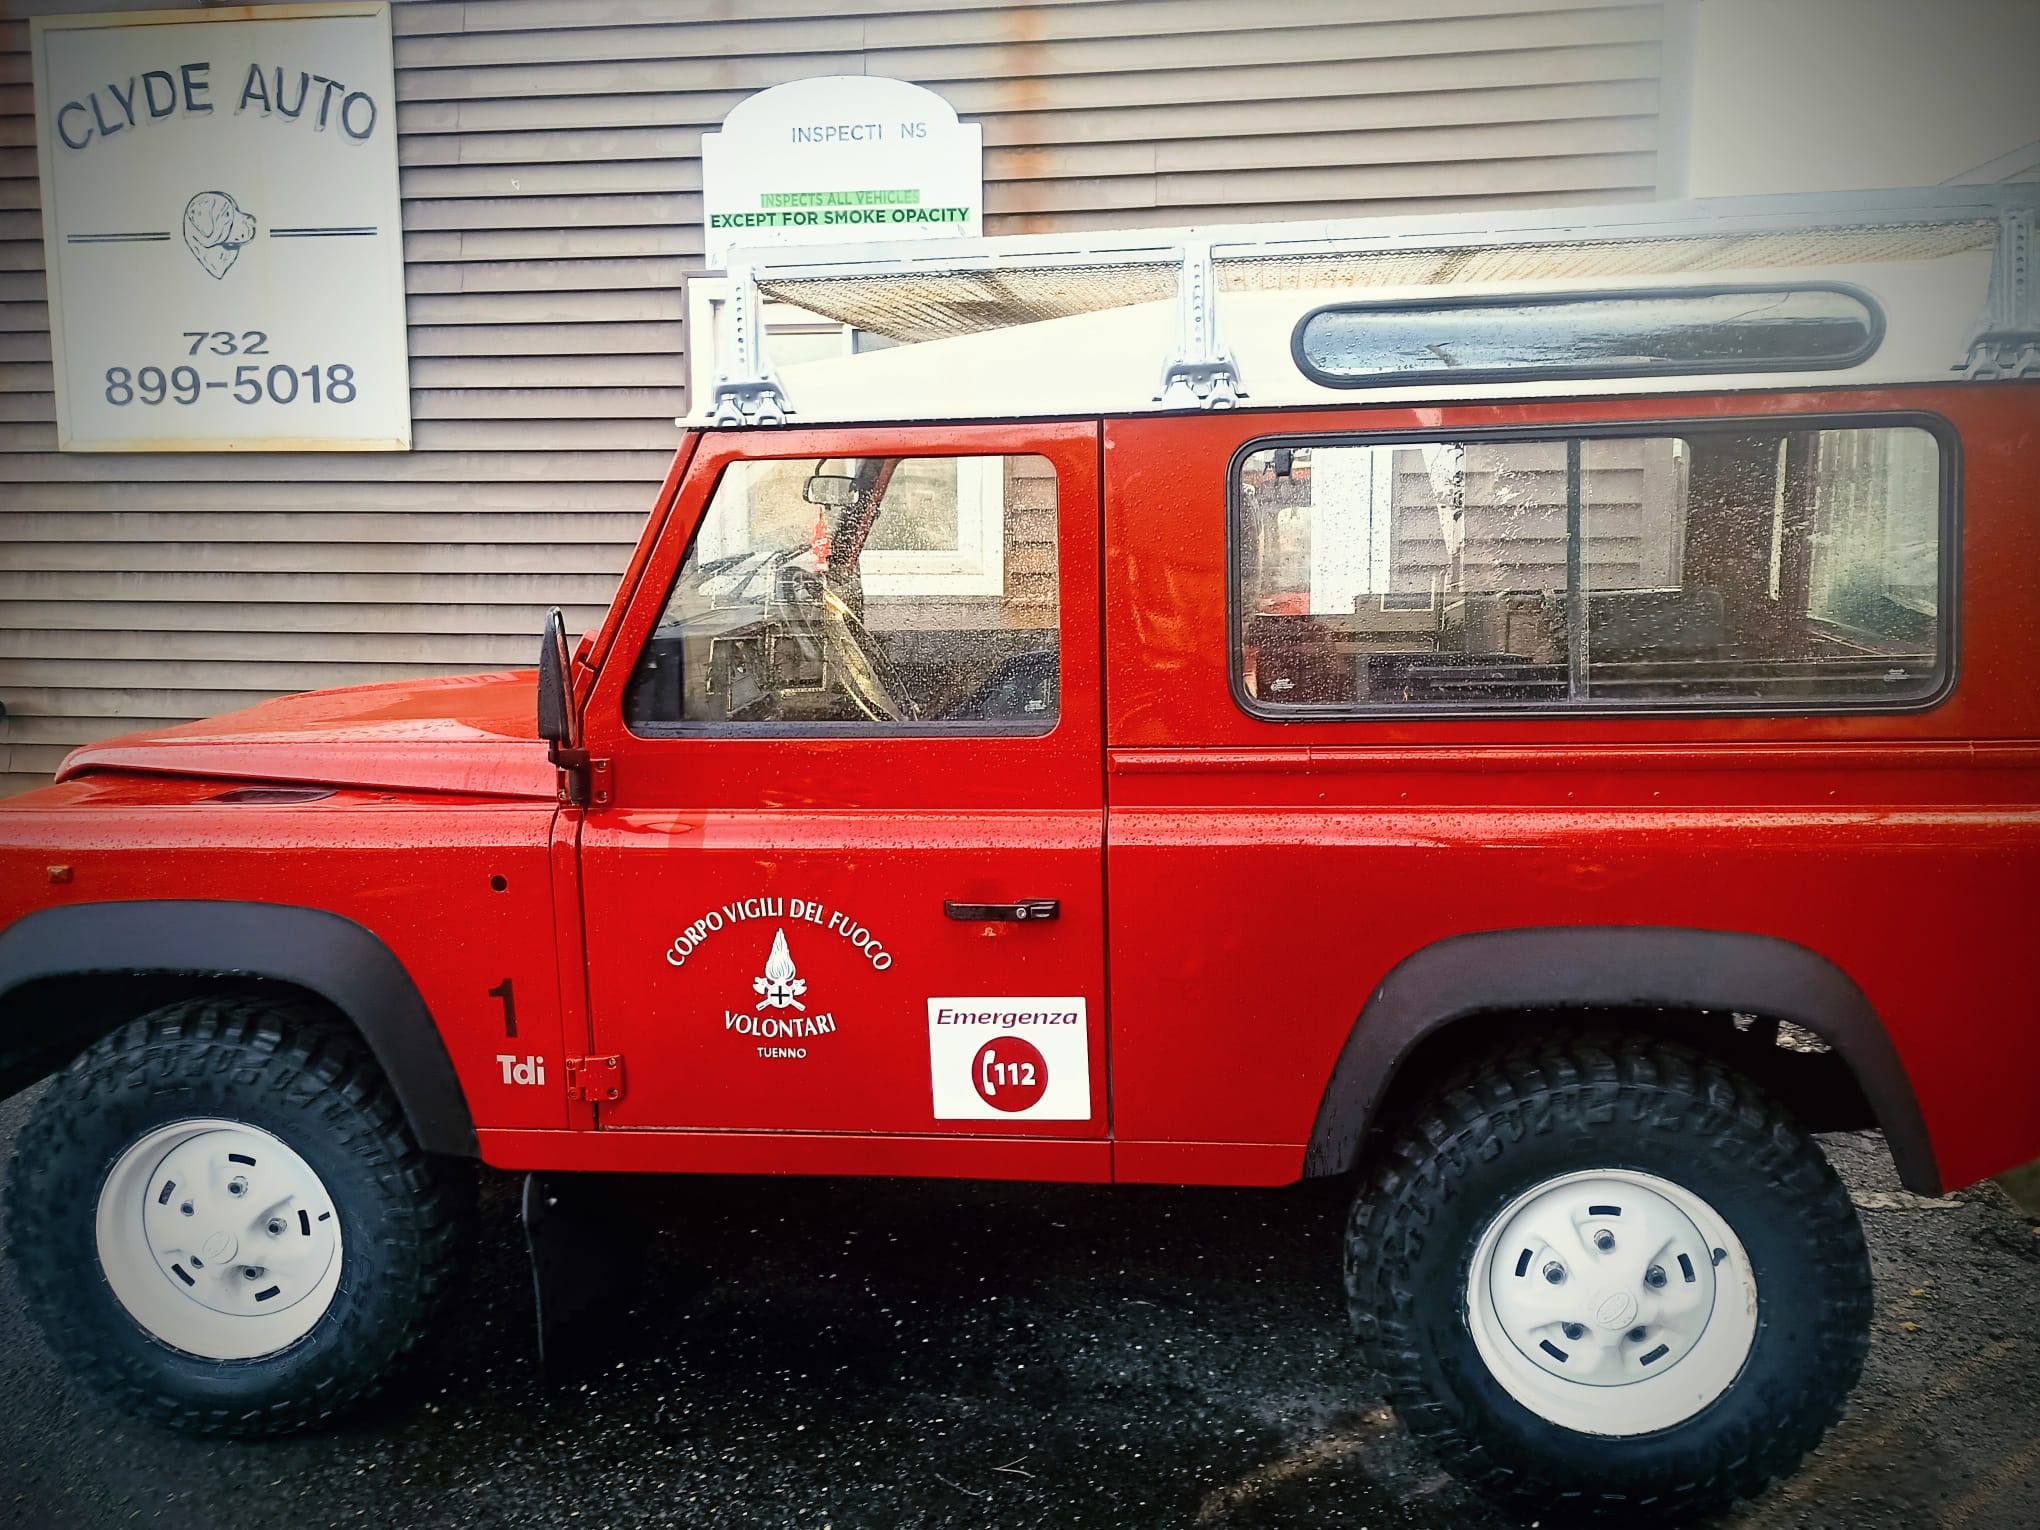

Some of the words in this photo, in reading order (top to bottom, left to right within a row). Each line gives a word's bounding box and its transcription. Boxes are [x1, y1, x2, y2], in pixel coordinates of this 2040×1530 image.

[57, 62, 213, 149] CLYDE
[236, 62, 377, 142] AUTO
[761, 192, 824, 209] INSPECTS
[827, 191, 853, 207] ALL
[855, 189, 920, 206] VEHICLES
[710, 212, 777, 229] EXCEPT
[781, 210, 819, 227] FOR
[823, 208, 887, 225] SMOKE
[891, 206, 970, 223] OPACITY
[183, 330, 269, 356] 732
[105, 363, 357, 407] 899-5018
[666, 911, 724, 967] CORPO
[722, 897, 783, 924] VIGILI
[789, 898, 824, 925] DEL
[827, 910, 893, 971] FUOCO
[488, 978, 518, 1038] 1
[936, 1008, 1078, 1029] Emergenza
[724, 1009, 837, 1038] VOLONTARI
[756, 1046, 808, 1059] TUENNO
[496, 1054, 546, 1086] Tdi
[994, 1062, 1036, 1086] 112
